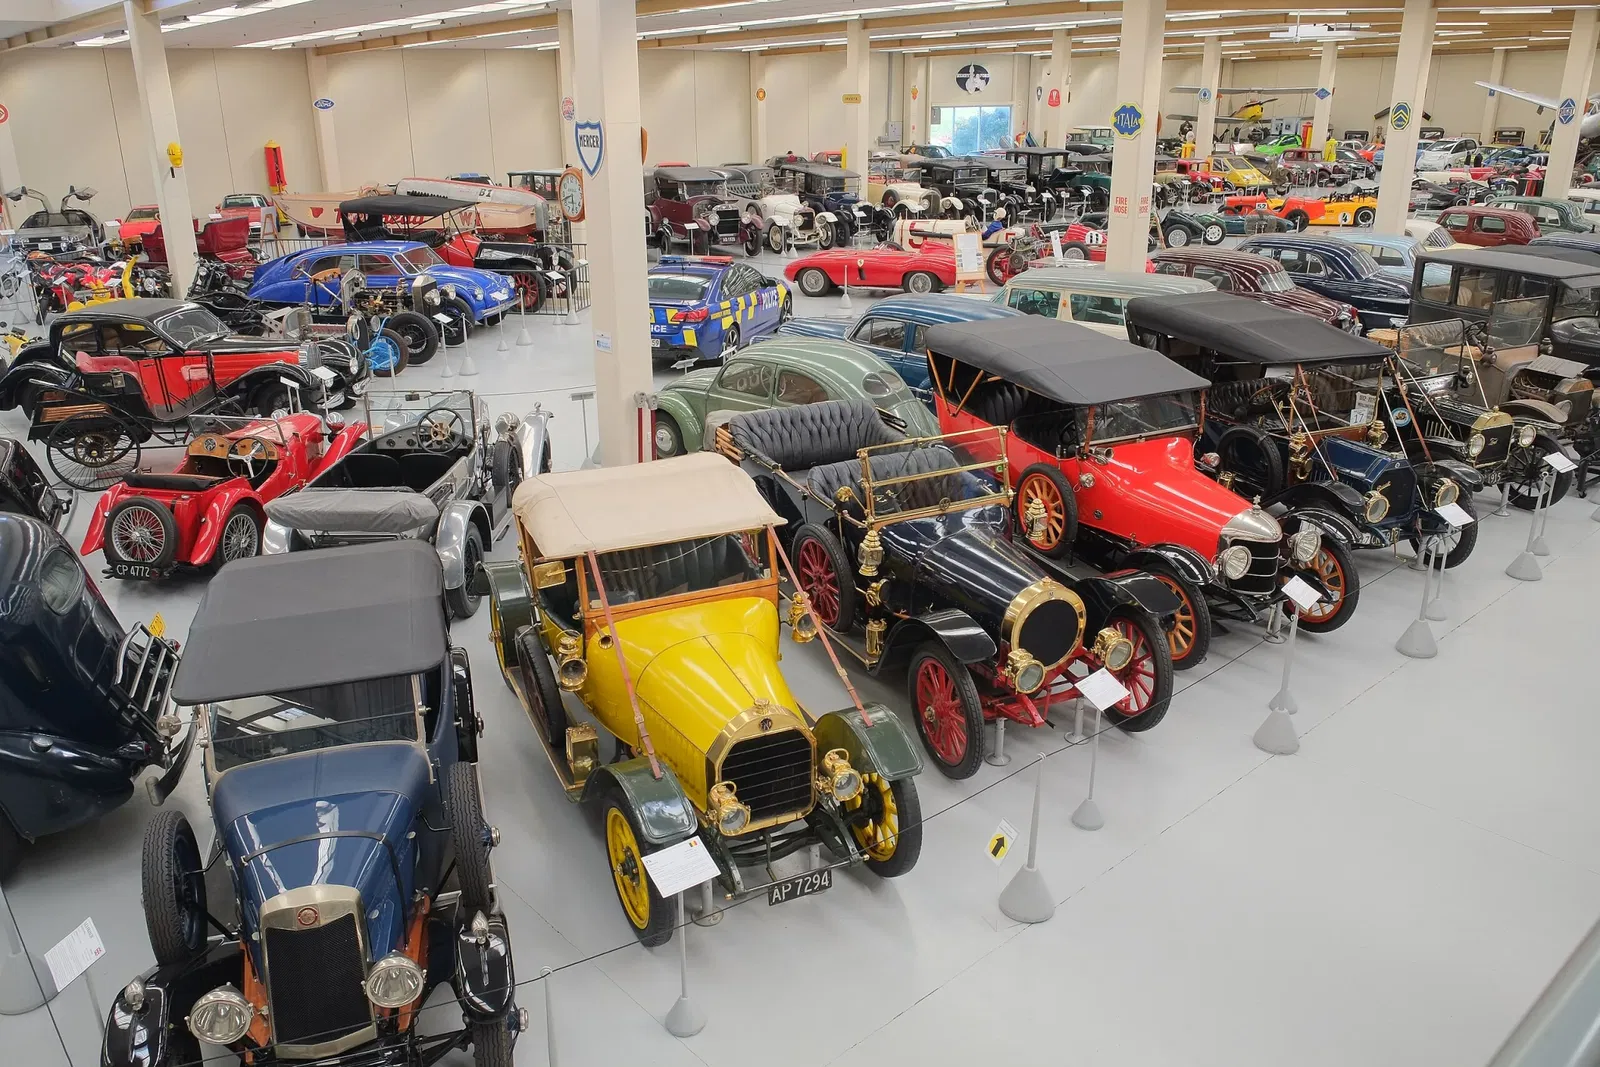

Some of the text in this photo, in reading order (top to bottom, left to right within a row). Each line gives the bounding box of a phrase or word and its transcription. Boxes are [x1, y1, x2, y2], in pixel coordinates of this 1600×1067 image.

[579, 134, 599, 148] MERCER
[1116, 196, 1127, 205] FIRE
[1114, 205, 1127, 214] HOSE
[762, 289, 777, 311] POLICE
[651, 324, 667, 333] ICE
[1354, 413, 1365, 424] 17
[116, 564, 151, 578] CP 4772
[772, 870, 830, 903] AP 7294
